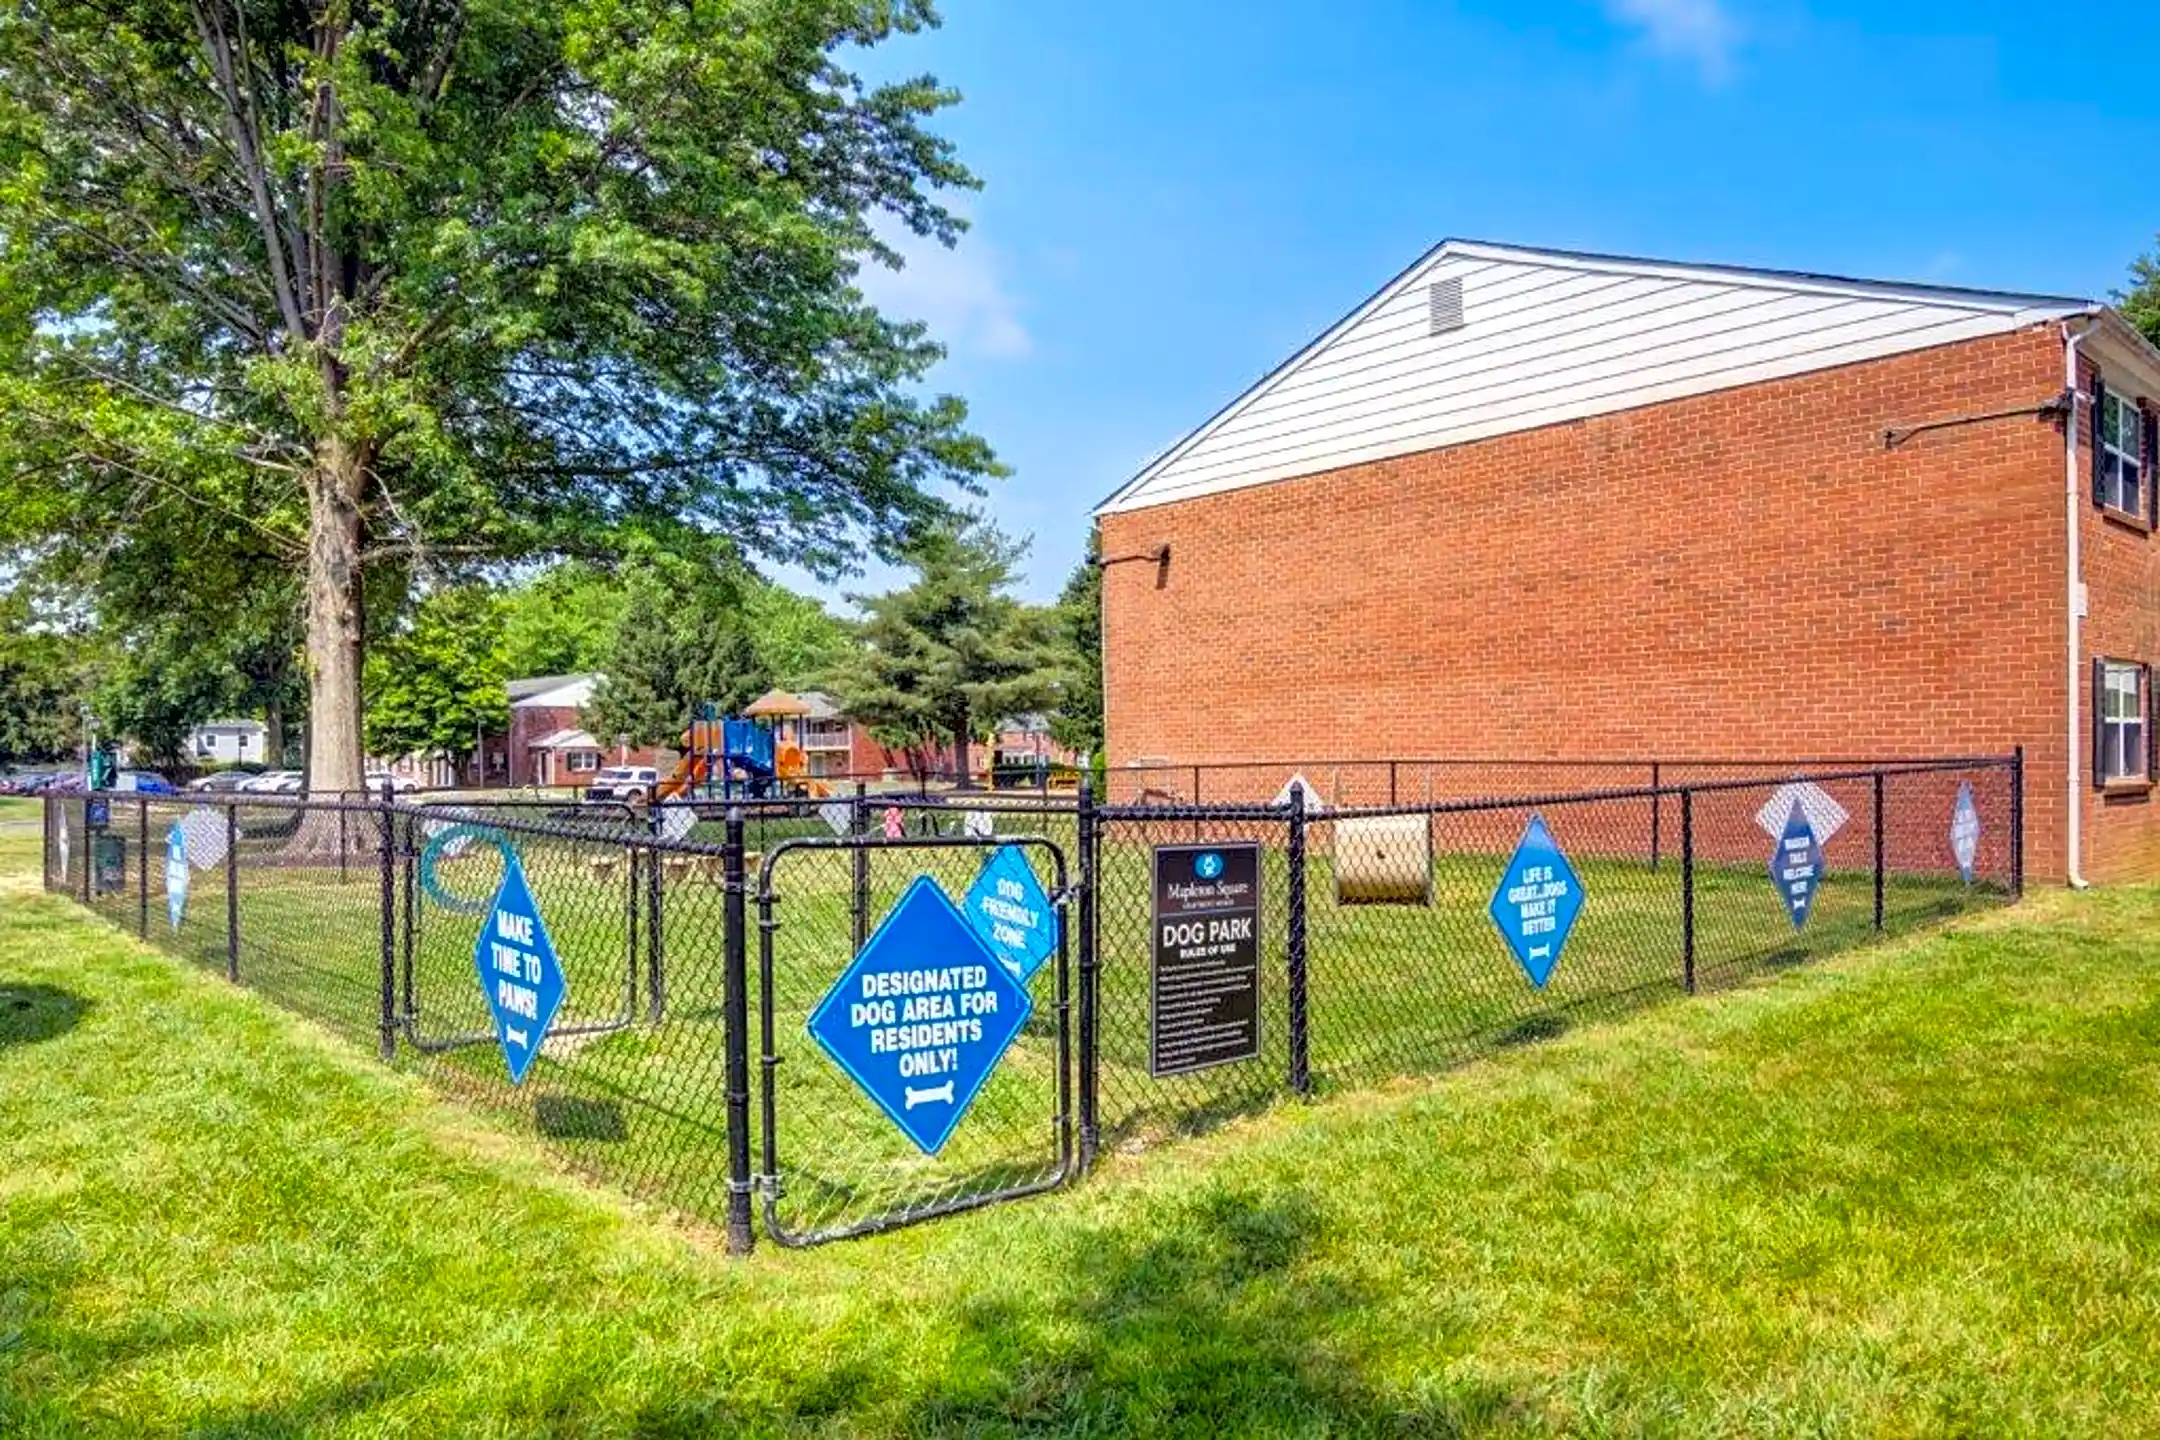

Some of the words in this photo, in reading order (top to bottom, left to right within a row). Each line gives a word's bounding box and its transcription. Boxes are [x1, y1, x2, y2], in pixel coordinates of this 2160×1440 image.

[996, 877, 1024, 902] DOG
[1216, 880, 1249, 899] Square
[1522, 866, 1543, 884] LIFE
[1543, 865, 1553, 881] IS
[980, 895, 1039, 929] FRIENDLY
[1521, 901, 1546, 919] MAKE
[497, 909, 534, 946] MAKE
[993, 920, 1027, 950] ZONE
[1163, 922, 1205, 948] DOG
[1209, 917, 1252, 941] PARK
[1522, 916, 1556, 936] BETTER
[491, 941, 521, 978] TIME
[522, 952, 542, 985] TO
[1207, 944, 1218, 955] OF
[862, 965, 987, 998] DESIGNATED
[498, 979, 537, 1020] PAWS!
[851, 999, 896, 1027] DOG
[902, 995, 955, 1021] AREA
[960, 991, 998, 1015] FOR
[871, 1019, 982, 1053] RESIDENTS
[899, 1048, 958, 1078] ONLY!
